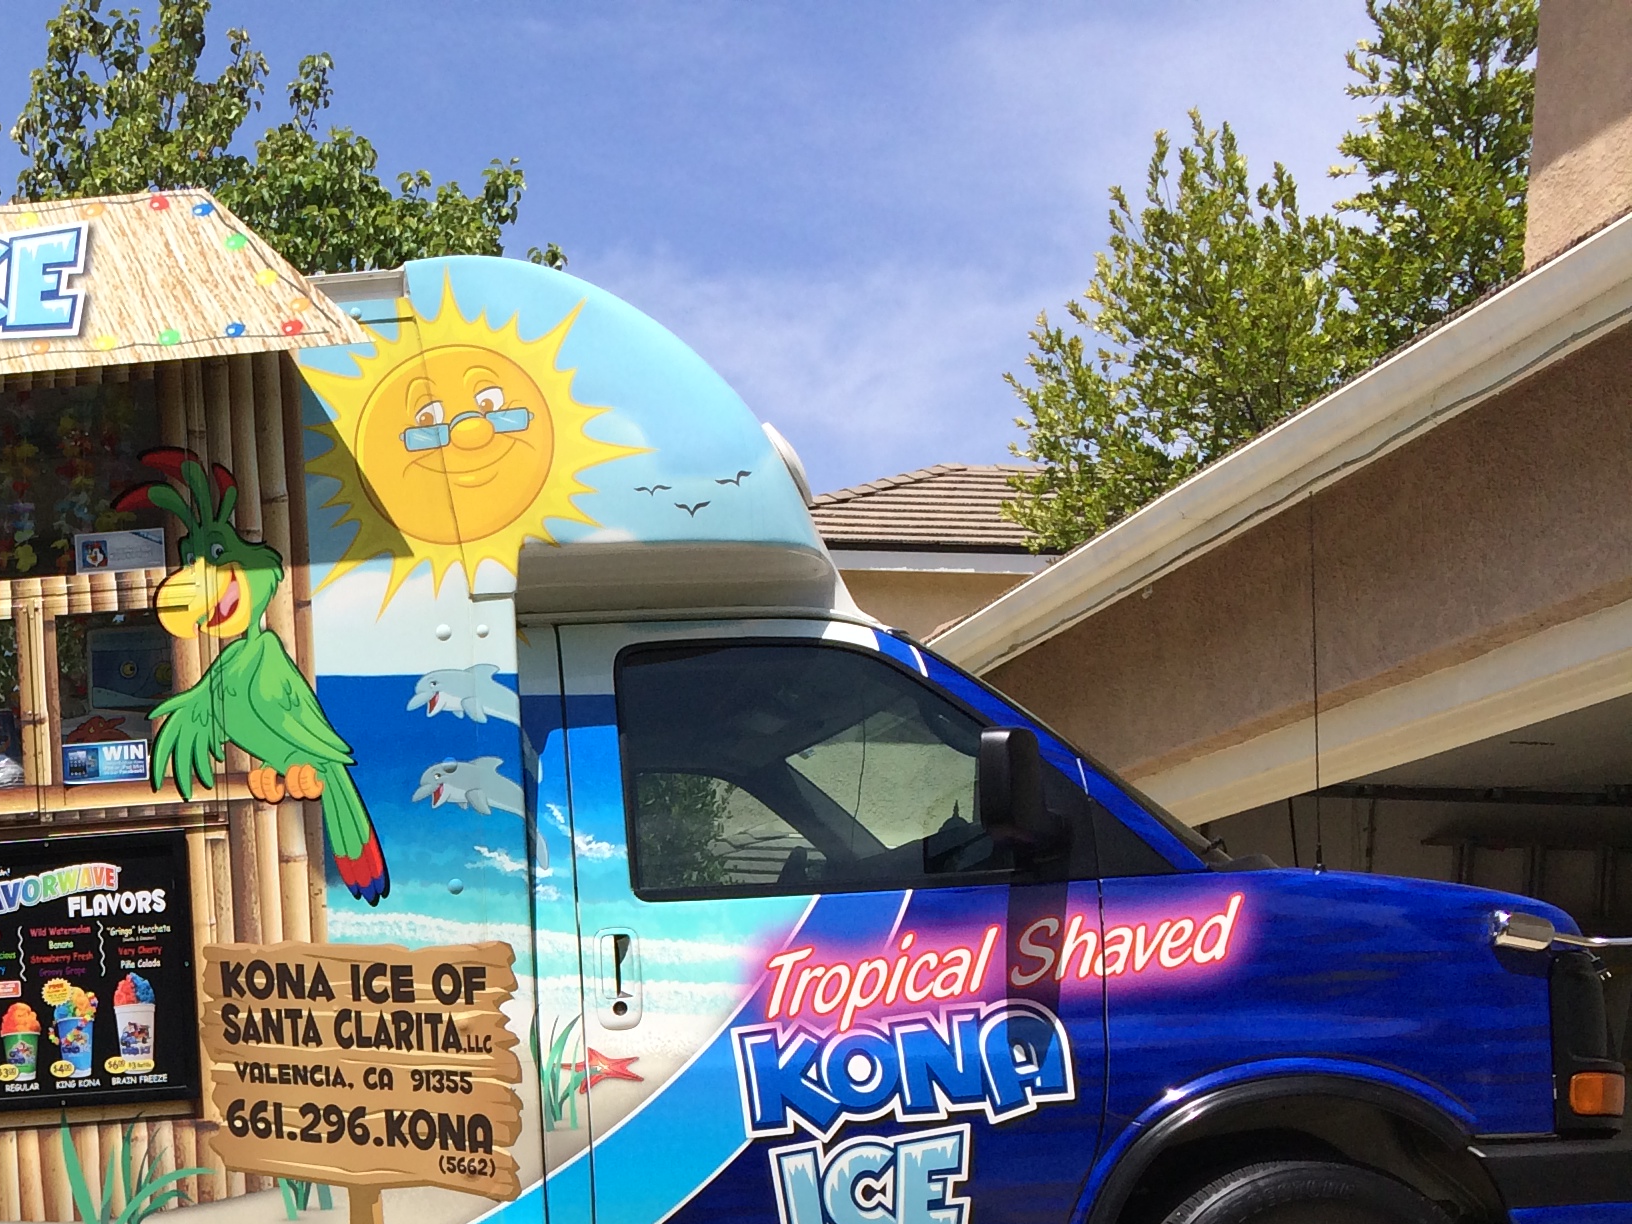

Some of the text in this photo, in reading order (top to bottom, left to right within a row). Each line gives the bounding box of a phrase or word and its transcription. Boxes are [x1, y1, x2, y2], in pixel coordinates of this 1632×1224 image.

[102, 744, 144, 761] WIN
[68, 889, 166, 918] FLAVORS
[29, 925, 91, 937] Wild Watermelon
[1009, 891, 1245, 988] Shaved
[48, 940, 74, 950] Banana
[137, 945, 163, 955] Cherry
[137, 958, 161, 968] Colada
[219, 958, 487, 1006] KONA ICE OF
[765, 923, 1001, 1032] Tropical
[221, 1002, 324, 1047] SANTA
[111, 1074, 168, 1086] BRAIN FREEZE
[233, 1060, 474, 1095] VALENCIA, CA 91355
[732, 1000, 1075, 1140] KONA
[5, 1082, 40, 1093] REGULAR
[56, 1078, 101, 1090] KING KONA
[226, 1098, 494, 1155] 661.296.KONA
[438, 1155, 497, 1179] (5662)
